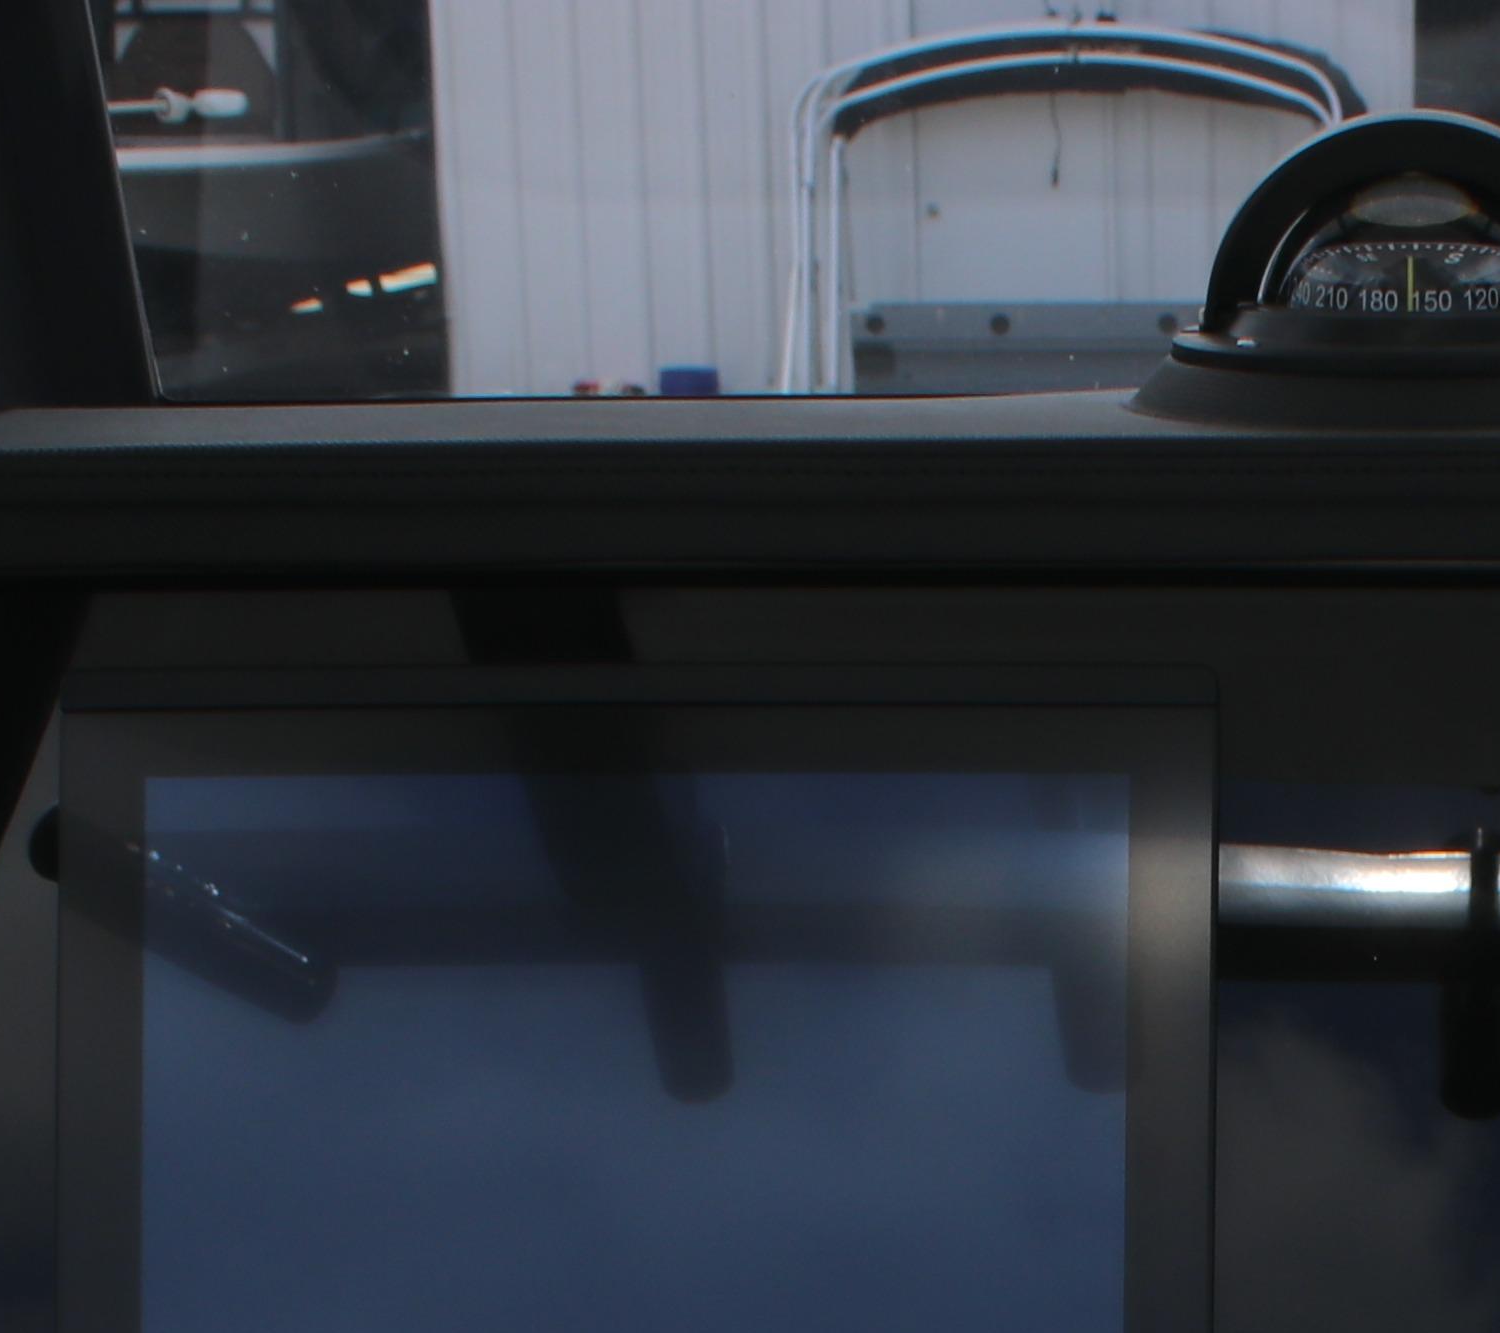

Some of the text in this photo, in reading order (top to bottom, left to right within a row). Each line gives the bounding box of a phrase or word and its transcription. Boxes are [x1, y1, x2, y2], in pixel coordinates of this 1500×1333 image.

[1315, 285, 1349, 311] 210
[1359, 288, 1399, 313] 180
[1412, 289, 1452, 313] 150
[1463, 285, 1499, 311] 120
